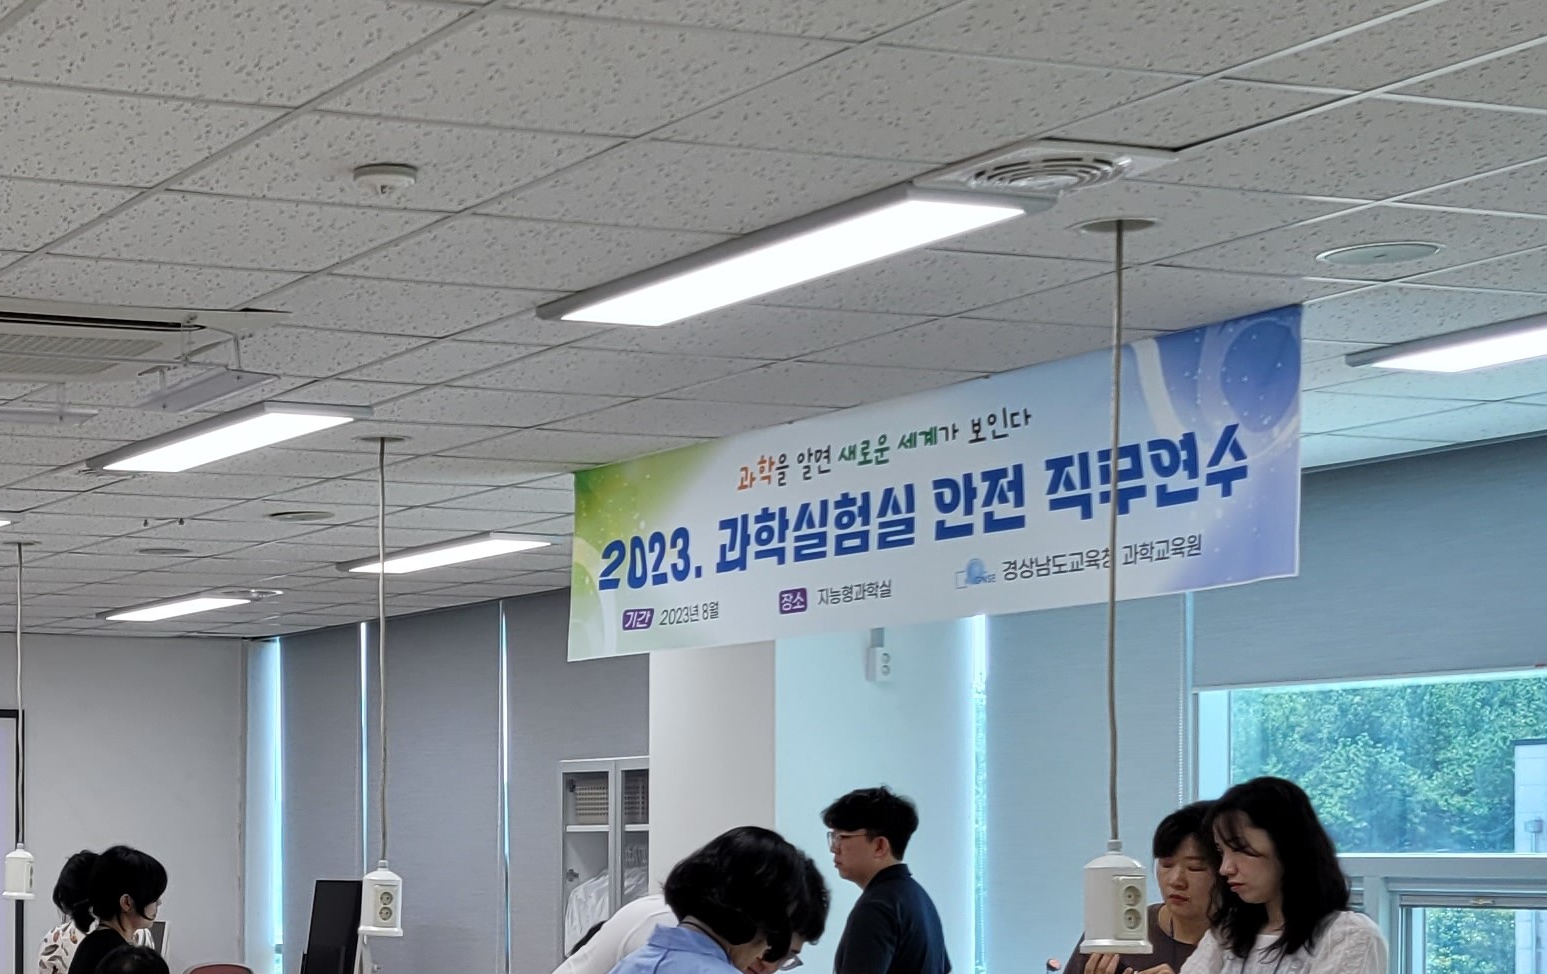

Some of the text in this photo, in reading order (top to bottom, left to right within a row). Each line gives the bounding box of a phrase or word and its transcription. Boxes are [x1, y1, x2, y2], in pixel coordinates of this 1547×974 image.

[736, 407, 1032, 491] 과학을 알면 새로운 세계가 보인다
[598, 423, 1249, 591] 2023. 과학실험실 안전 직무연수
[1121, 533, 1203, 566] 과학교육원
[780, 592, 805, 612] 장소
[817, 579, 893, 607] 지능형과학실
[624, 609, 652, 629] 기간
[658, 601, 720, 627] 2023년 8월
